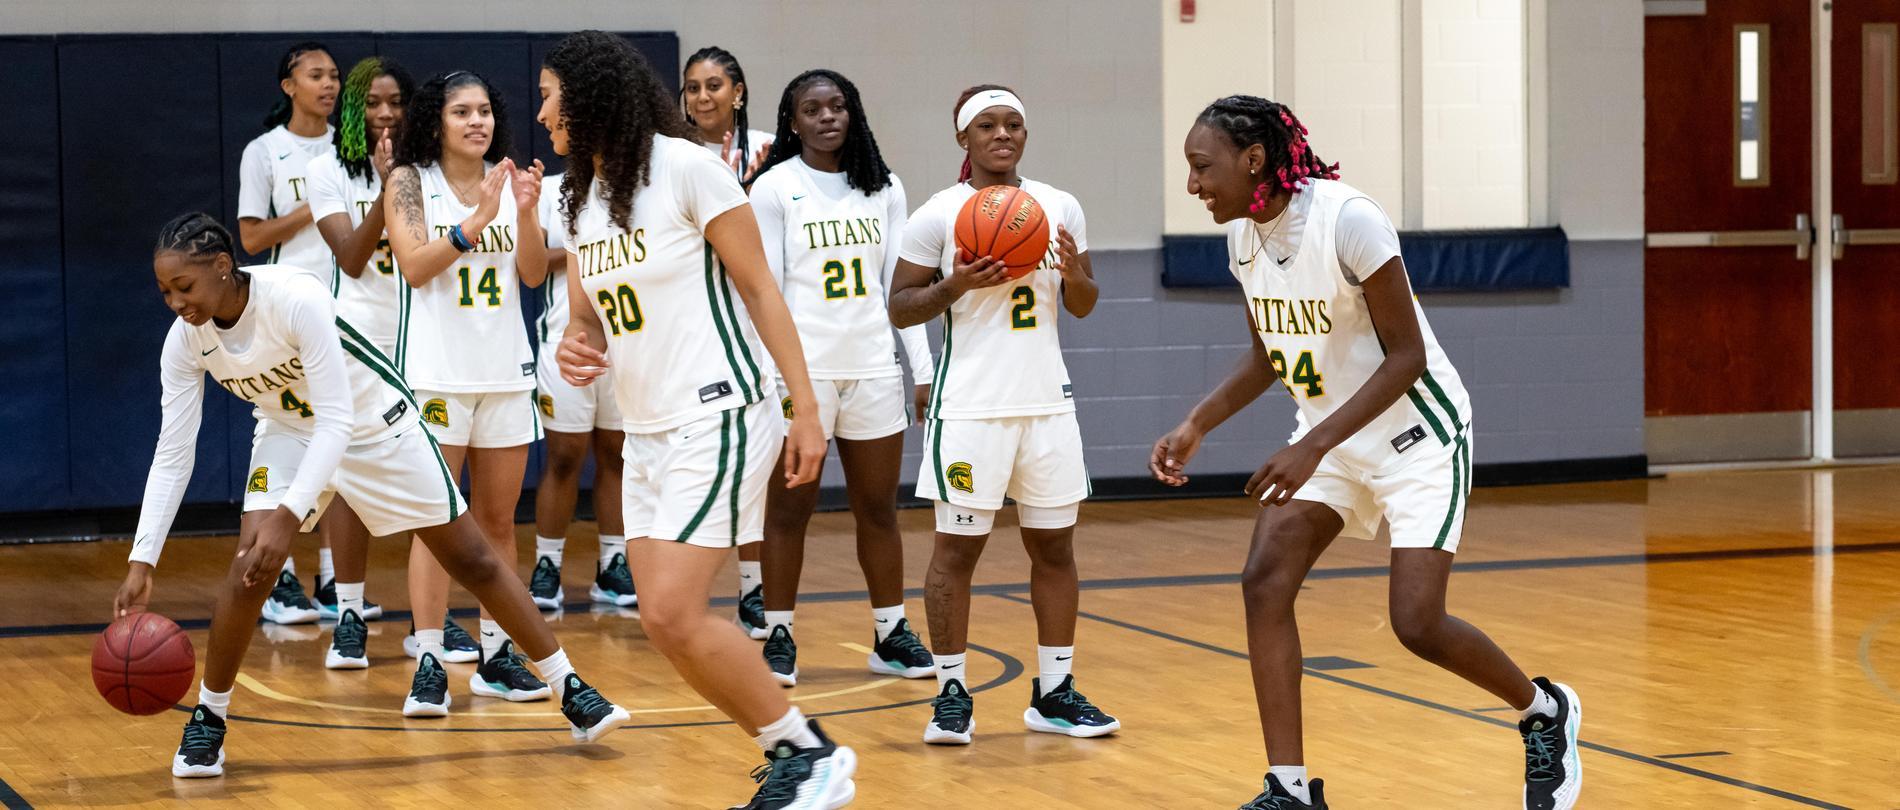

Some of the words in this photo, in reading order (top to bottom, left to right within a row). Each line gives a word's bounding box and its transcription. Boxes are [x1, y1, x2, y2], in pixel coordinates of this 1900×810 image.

[434, 225, 515, 253] TANS
[578, 228, 647, 279] TITANS
[803, 218, 882, 250] TITANS
[458, 266, 502, 308] 14
[822, 257, 867, 300] 21
[597, 282, 645, 337] 20
[1011, 285, 1037, 331] 2
[1252, 297, 1332, 335] TITANS
[220, 356, 304, 401] TITANS
[1268, 349, 1326, 399] 24
[279, 387, 315, 419] 4
